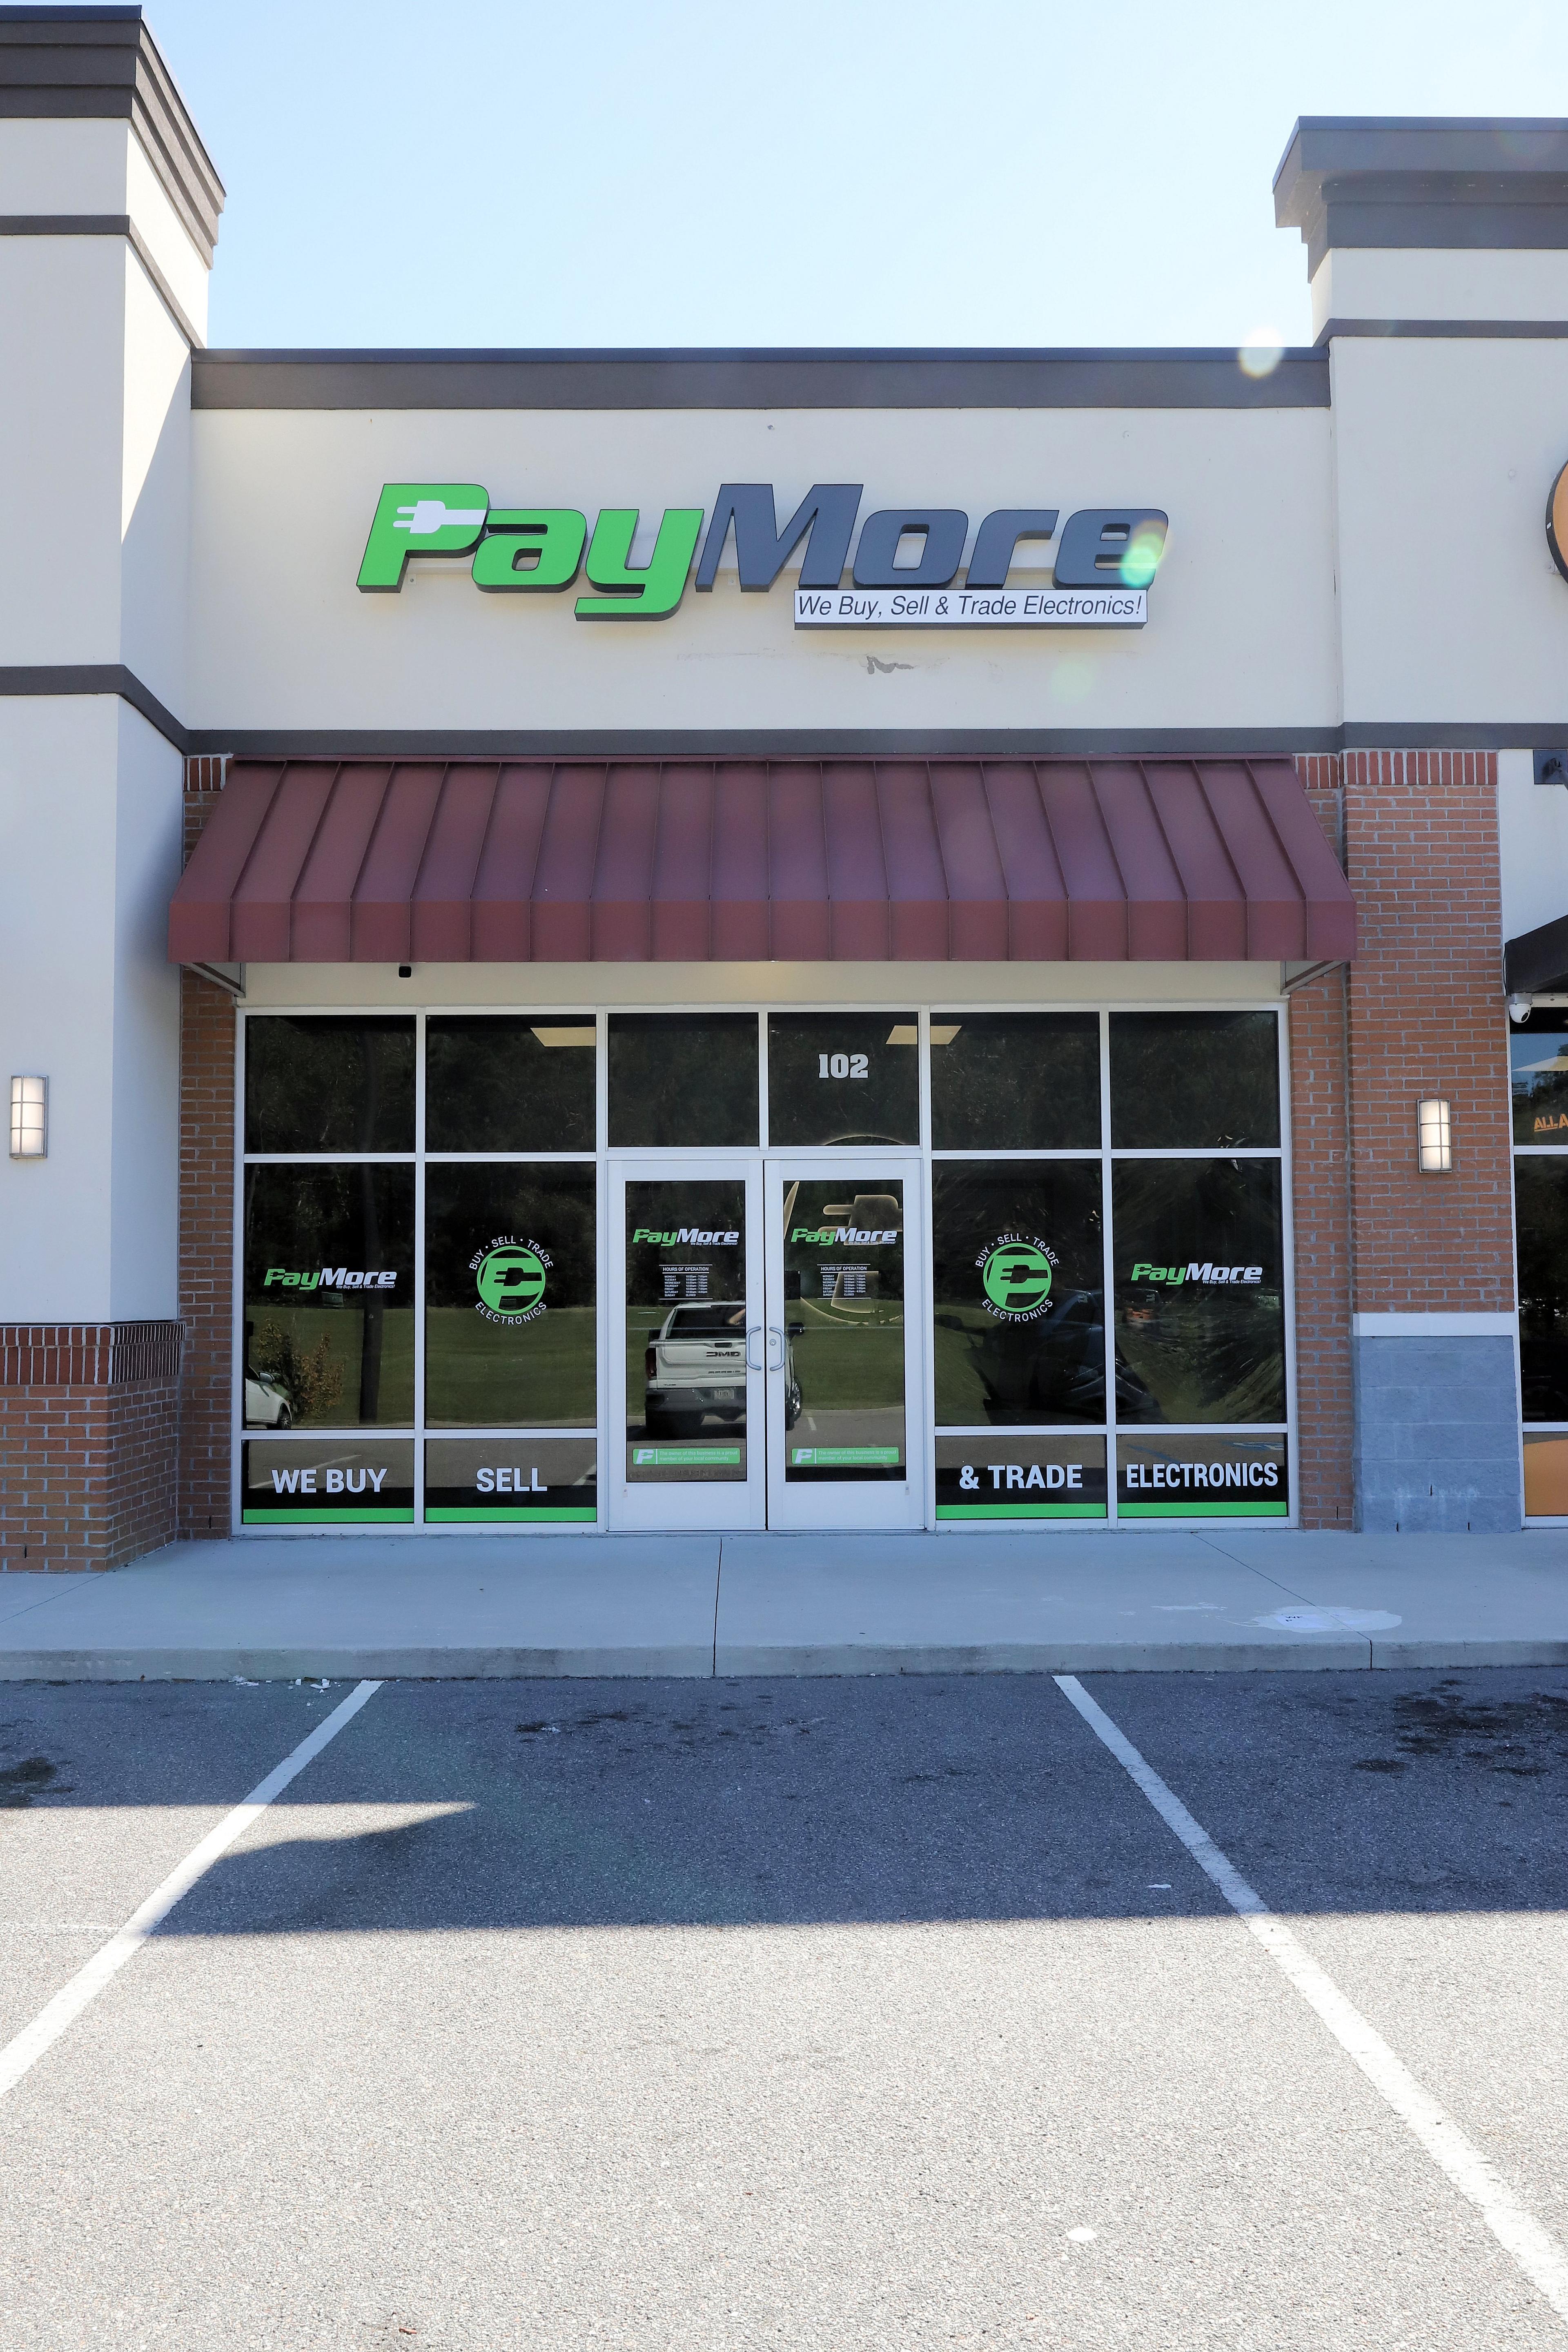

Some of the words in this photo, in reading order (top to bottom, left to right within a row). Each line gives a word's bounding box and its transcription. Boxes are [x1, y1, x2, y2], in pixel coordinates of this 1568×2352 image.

[356, 483, 1168, 620] PayMore
[799, 595, 832, 615] We
[839, 595, 882, 620] Buy,
[891, 595, 930, 615] Sell
[935, 596, 949, 615] &
[958, 595, 1016, 615] Trade
[1024, 595, 1142, 615] Electronics!
[819, 1054, 869, 1078] 102
[633, 1228, 739, 1247] PayMore
[791, 1227, 898, 1246] PayMore
[469, 1249, 484, 1270] BUY
[491, 1236, 516, 1247] SELL
[527, 1239, 554, 1269] TRADE
[975, 1246, 990, 1267] BUY
[997, 1233, 1022, 1245] SELL
[1033, 1237, 1059, 1266] TRADE
[264, 1268, 397, 1290] PayMore
[1131, 1263, 1263, 1285] PayMore
[475, 1301, 547, 1325] ELECTRONICS
[982, 1298, 1053, 1322] ELECTRONICS
[272, 1468, 316, 1493] WE
[326, 1468, 388, 1492] BUY
[477, 1468, 547, 1492] SELL
[960, 1466, 980, 1489] &
[988, 1465, 1082, 1489] TRADE
[1127, 1462, 1278, 1488] ELECTRONICS
